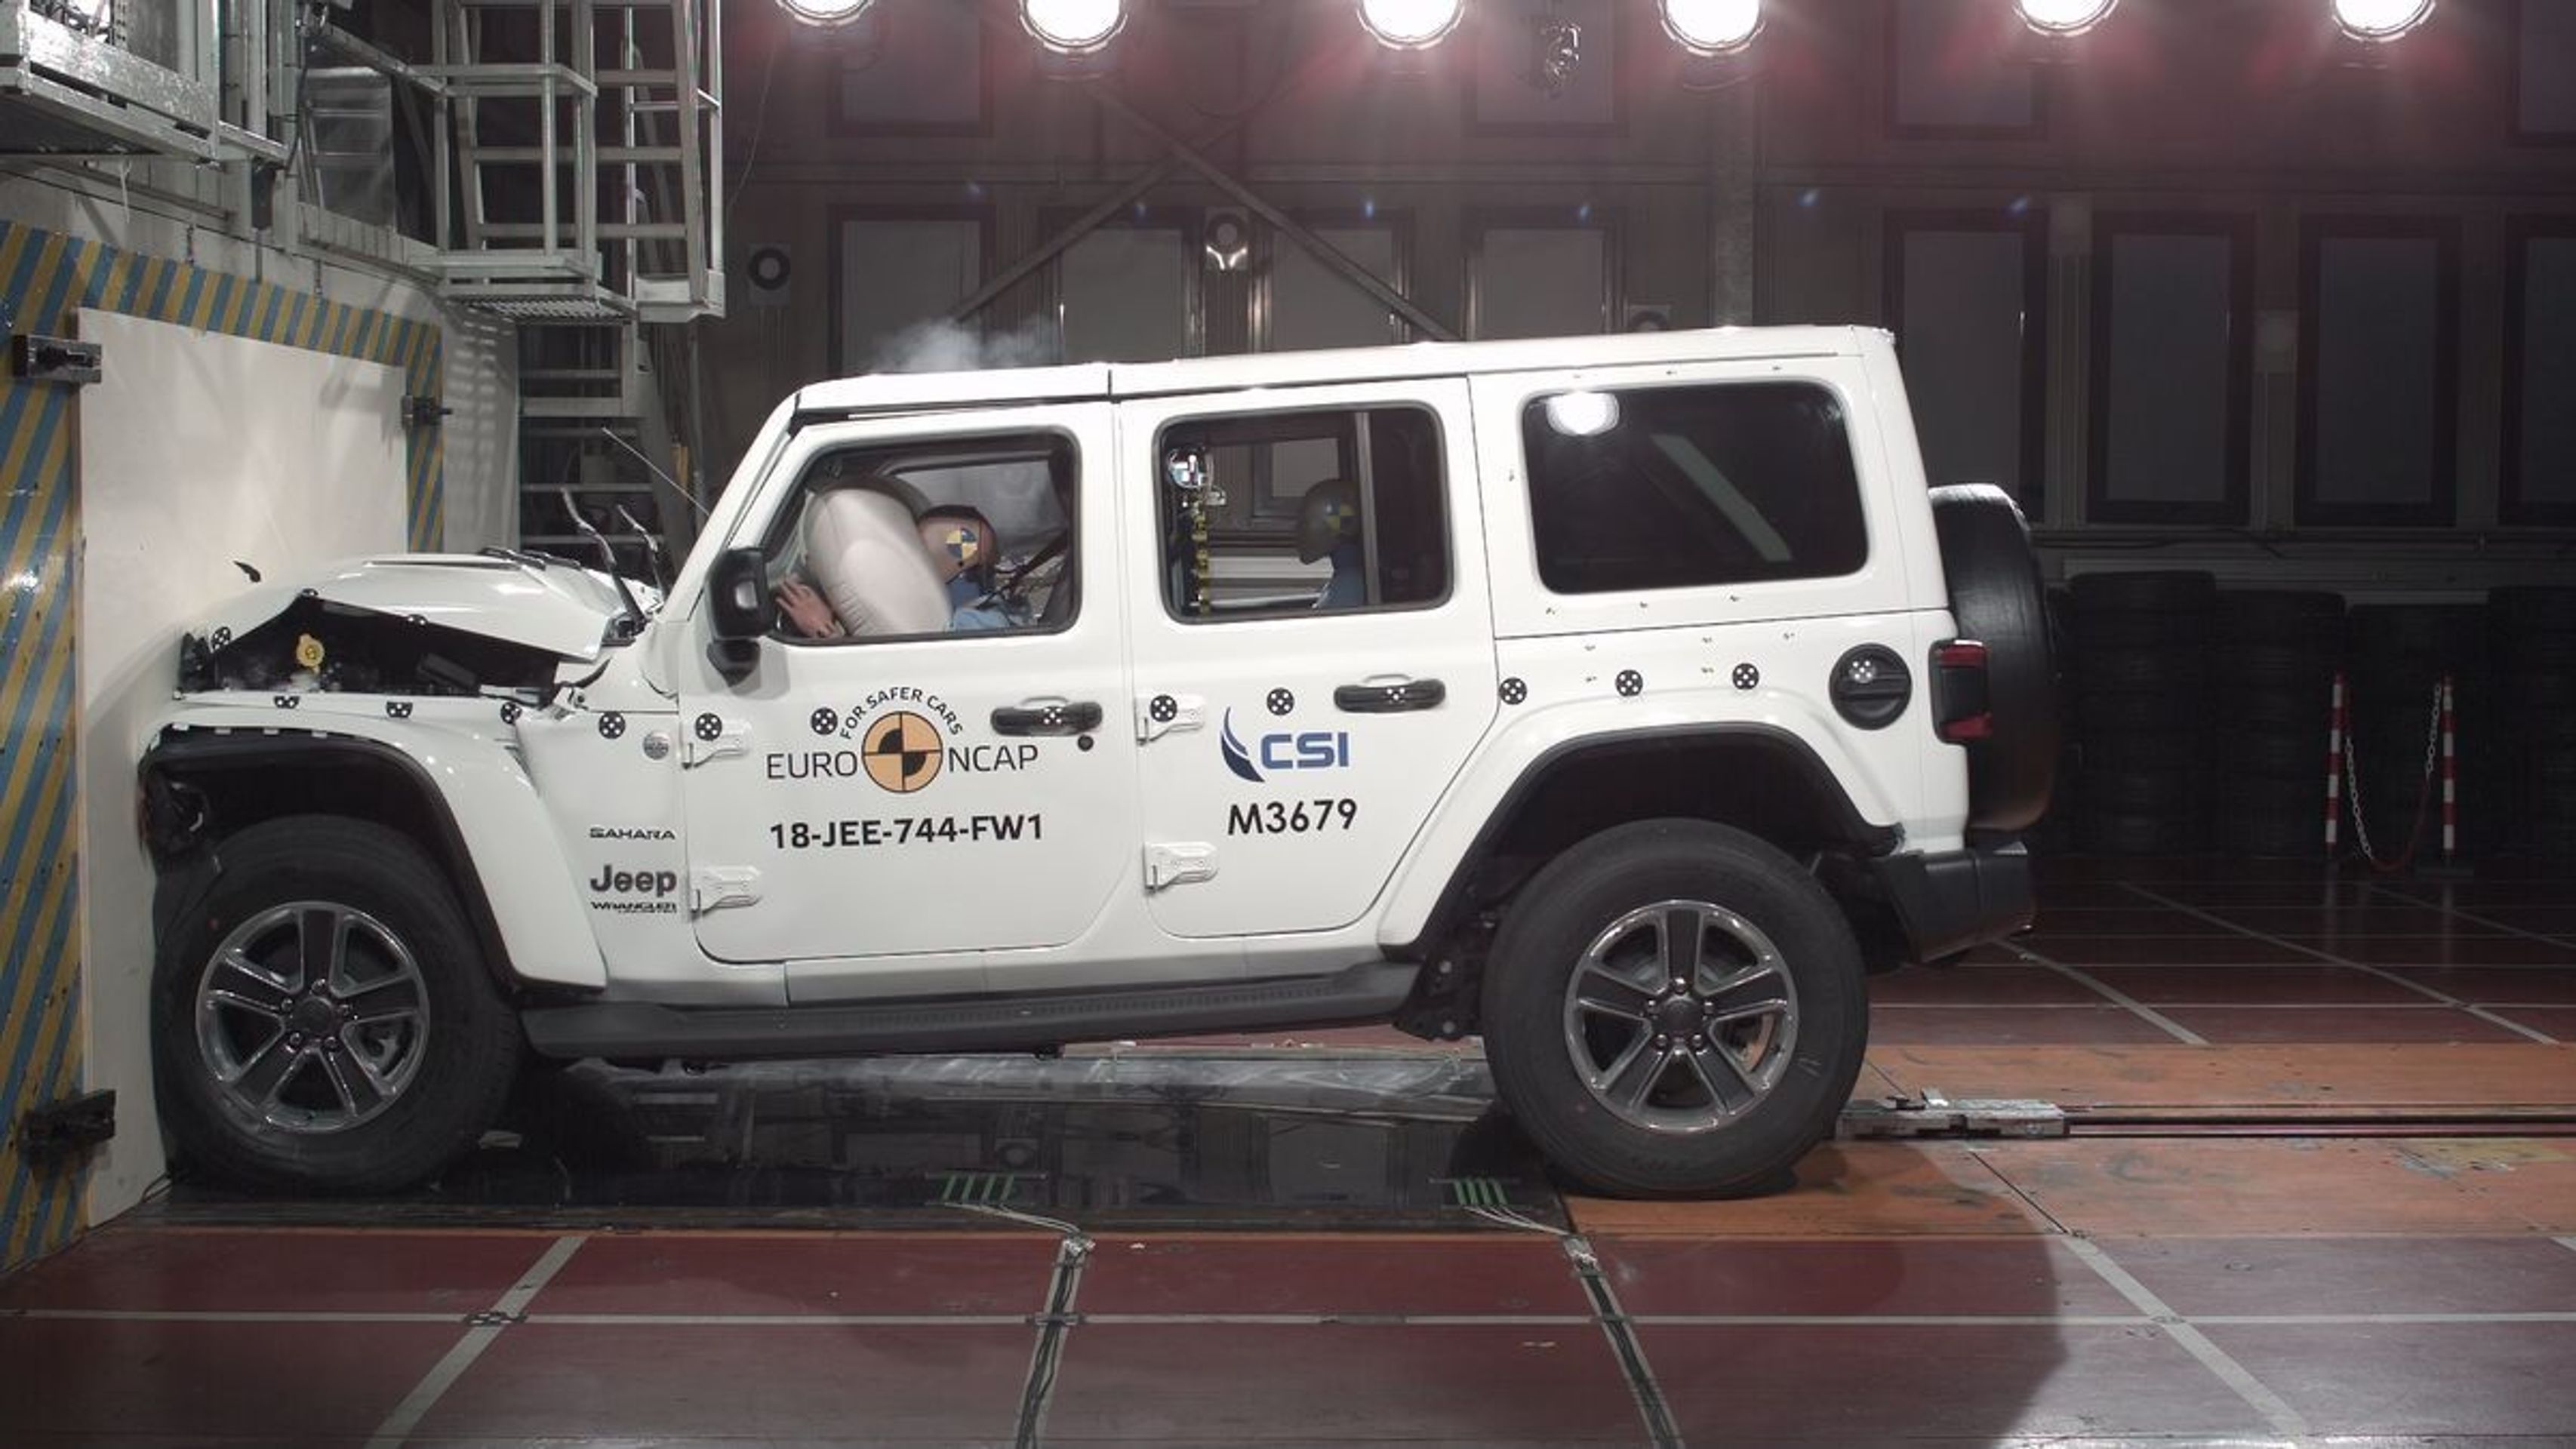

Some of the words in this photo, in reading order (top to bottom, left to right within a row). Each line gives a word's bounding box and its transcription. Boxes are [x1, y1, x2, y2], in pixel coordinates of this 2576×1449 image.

[840, 706, 866, 740] FOR
[866, 687, 922, 709] SAFER
[927, 695, 963, 735] CARS
[767, 751, 857, 780] EURO
[949, 744, 1039, 773] NCAP
[1260, 732, 1349, 769] CSI
[589, 827, 676, 840] SAHARA
[770, 814, 1042, 849] 18-JEE-744-FW1
[1227, 798, 1357, 835] M3679
[590, 864, 677, 897] Jeep
